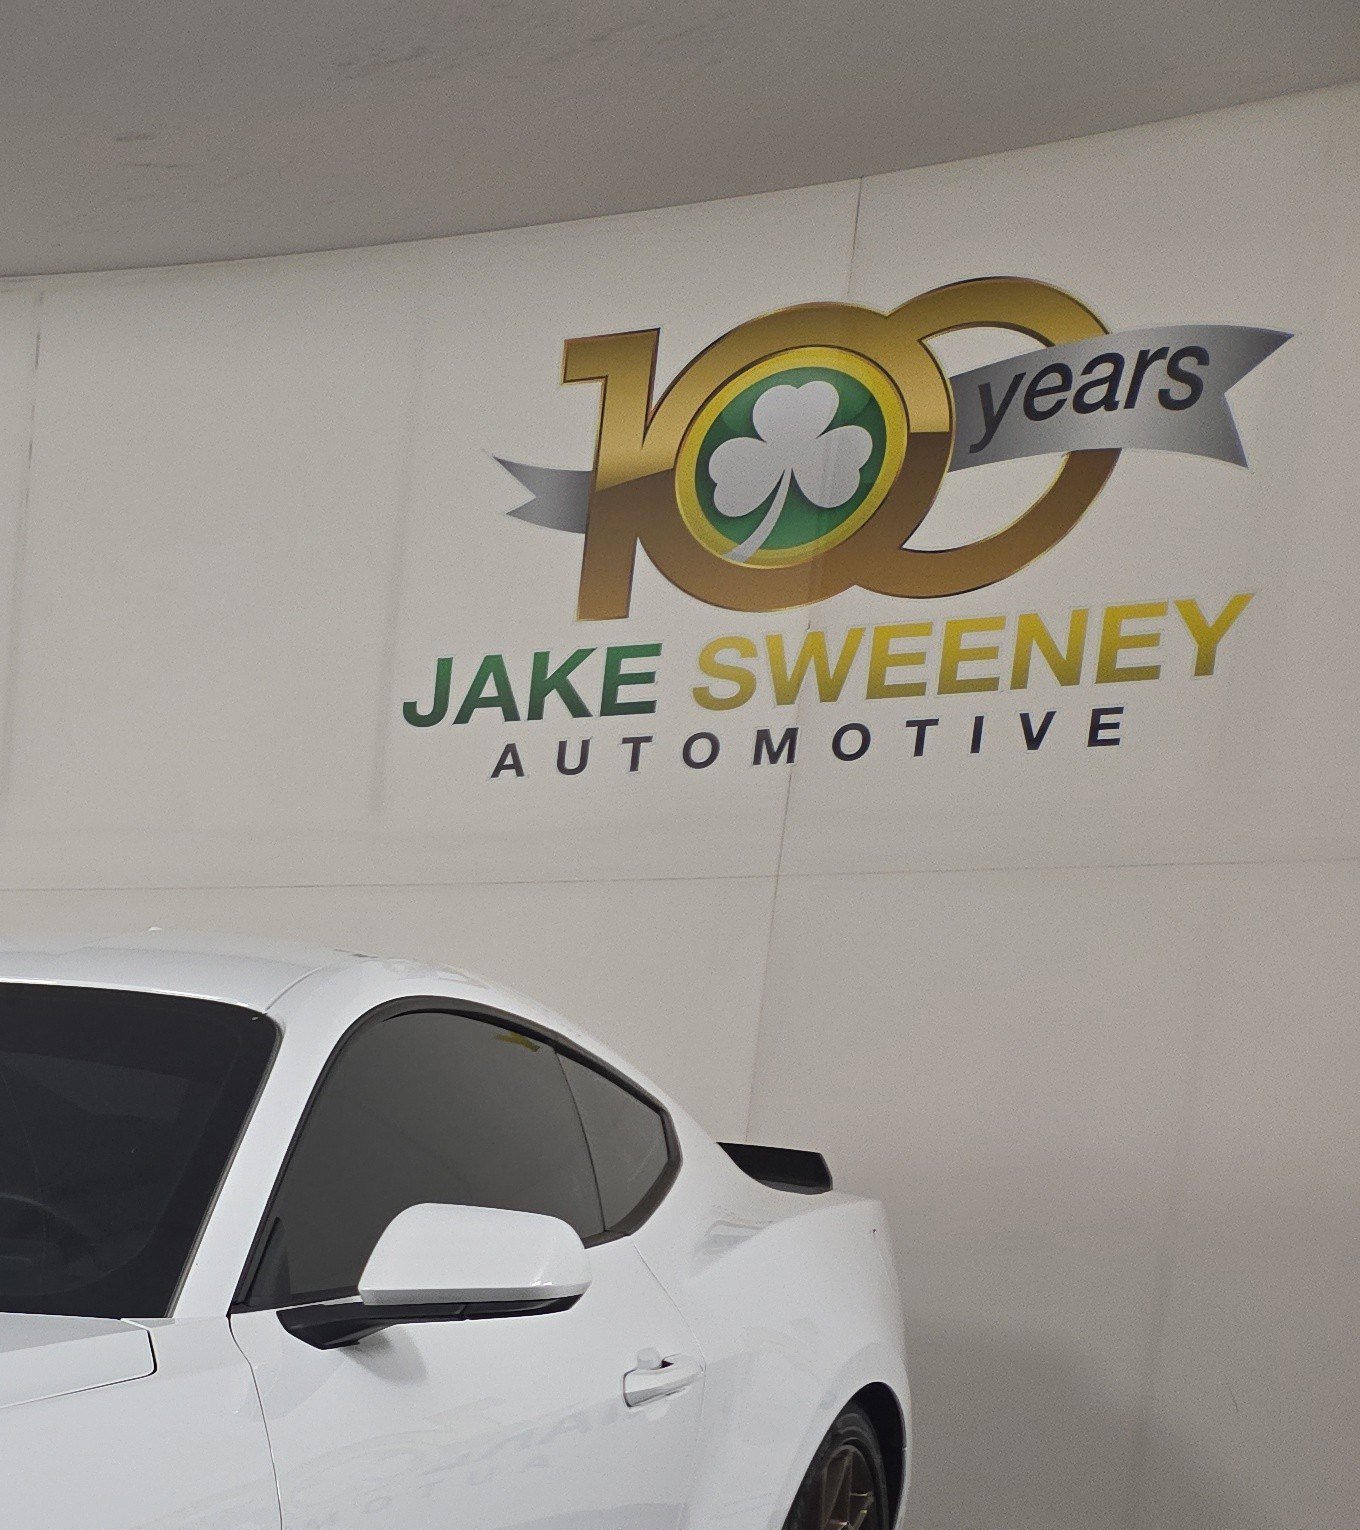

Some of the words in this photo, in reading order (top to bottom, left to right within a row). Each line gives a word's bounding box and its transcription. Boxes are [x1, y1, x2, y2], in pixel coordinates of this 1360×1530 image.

[561, 275, 1122, 622] 100
[969, 345, 1210, 453] years
[402, 643, 663, 728] JAKE
[691, 593, 1254, 711] SWEENEY
[490, 707, 1125, 779] AUTOMOTIVE
